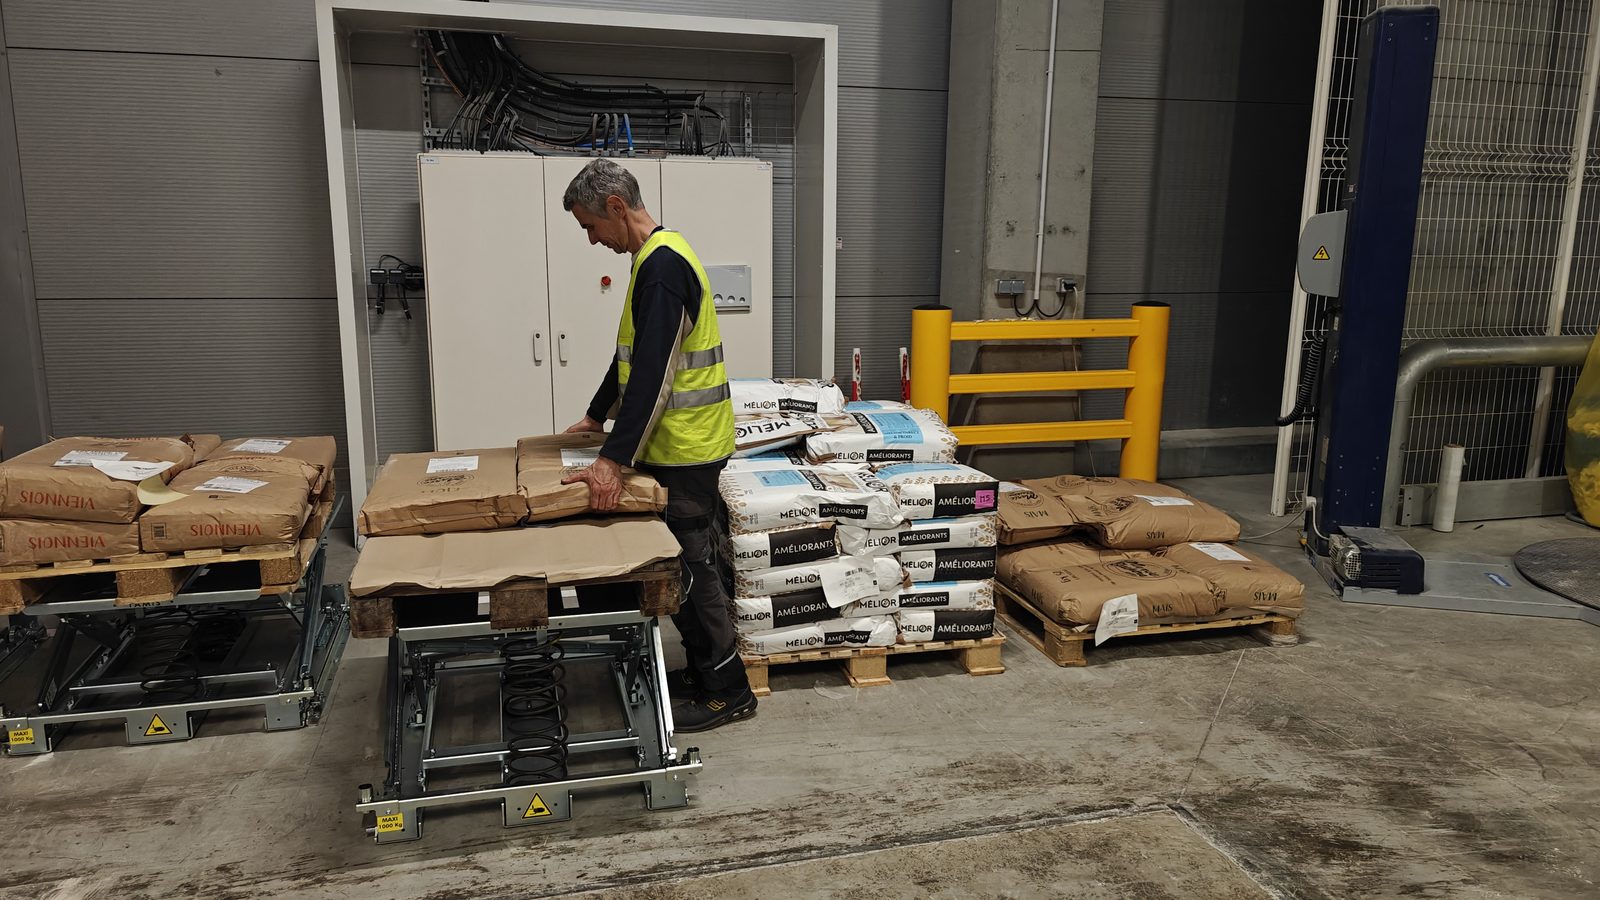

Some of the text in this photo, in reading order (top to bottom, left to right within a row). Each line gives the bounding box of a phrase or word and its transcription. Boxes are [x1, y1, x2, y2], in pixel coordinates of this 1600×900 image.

[735, 420, 791, 438] MÉLIO
[868, 452, 911, 460] AMÉLIORANTS
[20, 490, 95, 510] VIENNOIS
[191, 523, 262, 536] VIENNOIS
[901, 532, 948, 541] AMÉLIORANTS
[28, 535, 106, 550] VIENNOIS
[774, 540, 834, 555] AMÉLIORANTS
[938, 559, 994, 569] AMÉLIORANTS
[776, 602, 829, 618] AMÉLIORAN
[937, 622, 992, 633] AMÉLIORANTS
